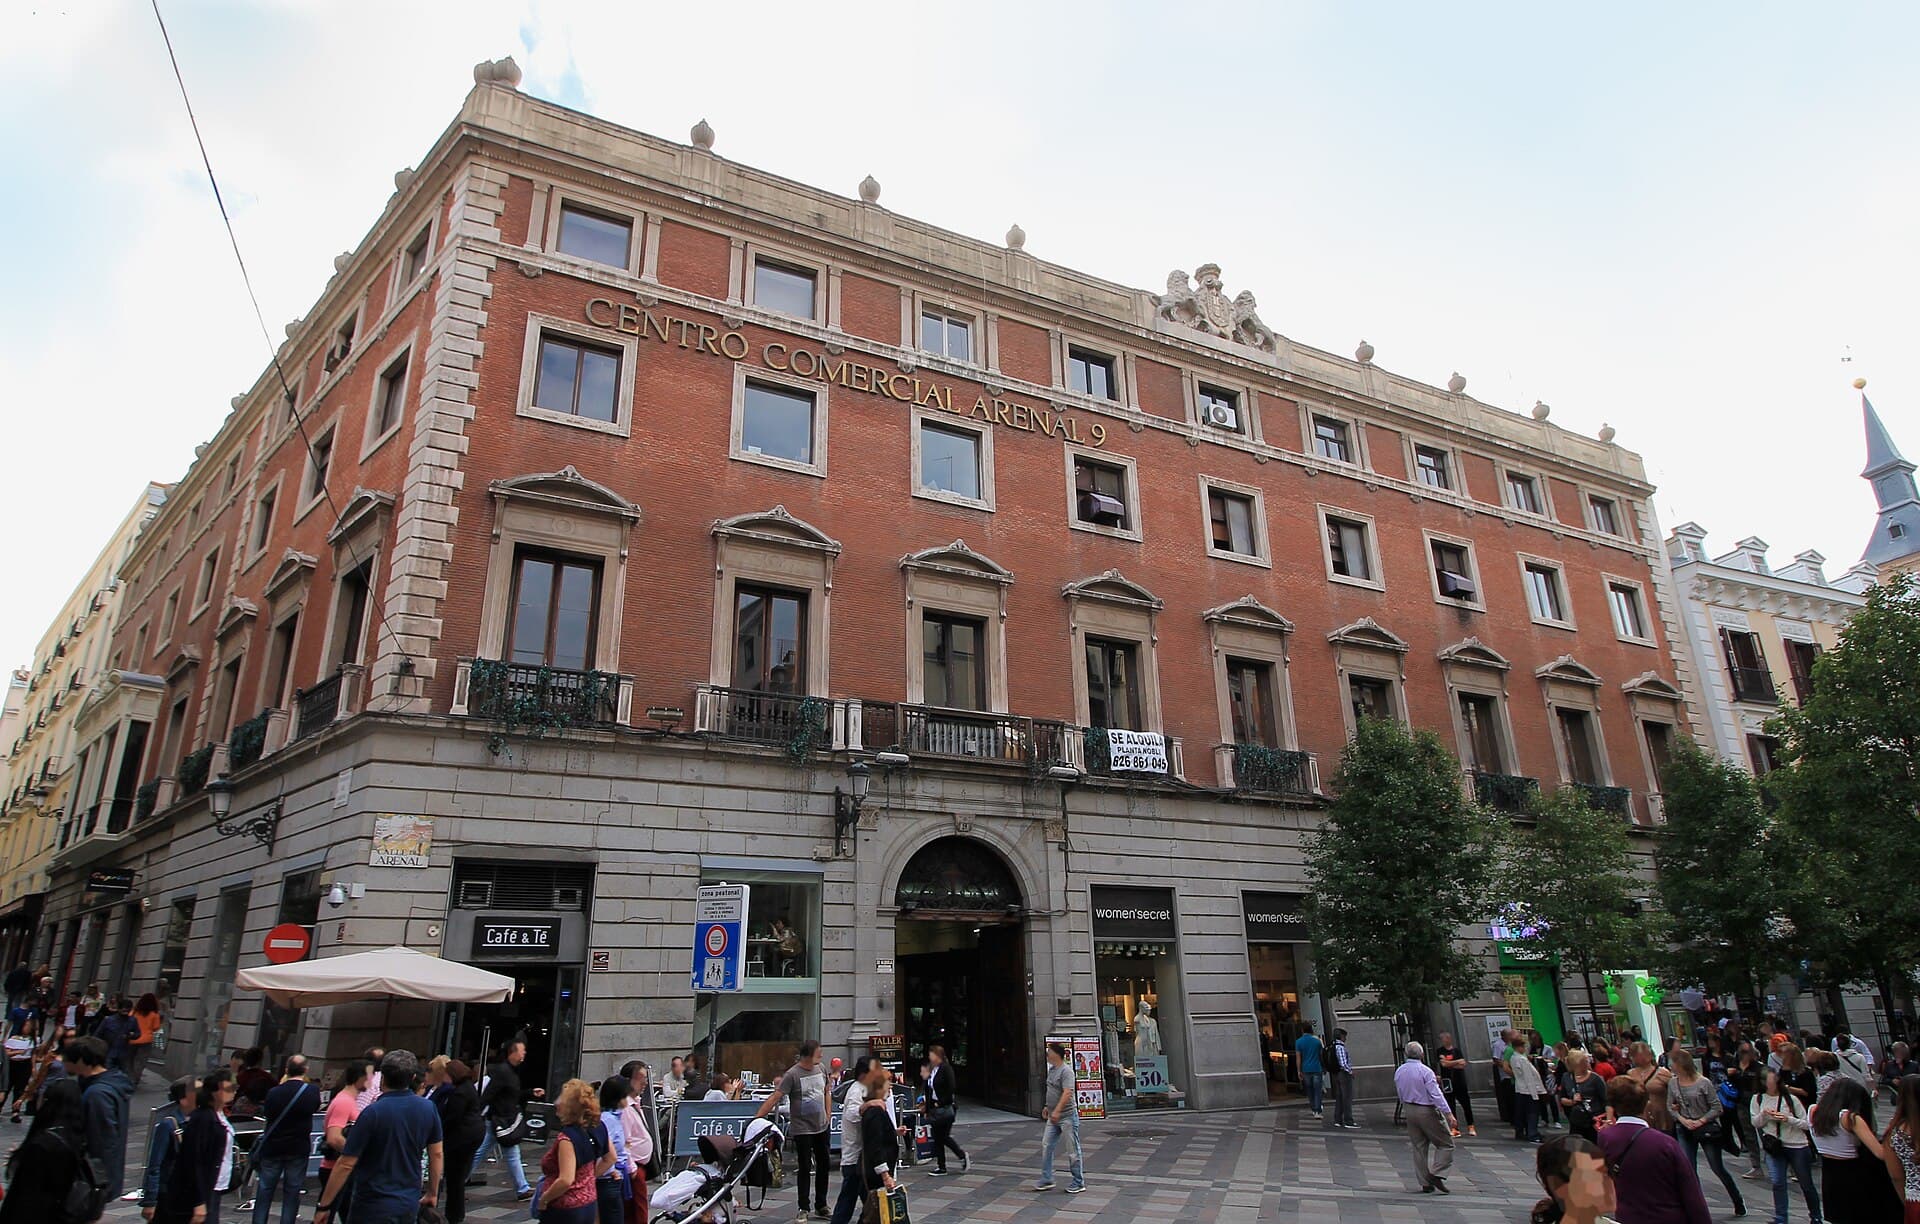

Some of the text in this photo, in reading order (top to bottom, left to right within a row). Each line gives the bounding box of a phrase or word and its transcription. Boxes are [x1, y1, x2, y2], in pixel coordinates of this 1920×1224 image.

[585, 298, 1107, 448] CENTRO COMERCIAL ARENAL 9
[1110, 732, 1164, 747] SE ALQUILA
[1117, 746, 1142, 754] PLANTA
[1112, 755, 1167, 770] 626 861 045
[375, 855, 424, 866] ARENAL
[1095, 908, 1170, 920] women'secret
[1247, 912, 1304, 924] women'sec
[486, 928, 548, 944] Café & Té
[872, 1036, 902, 1045] TALLER
[693, 1120, 723, 1136] Café
[726, 1124, 734, 1135] &
